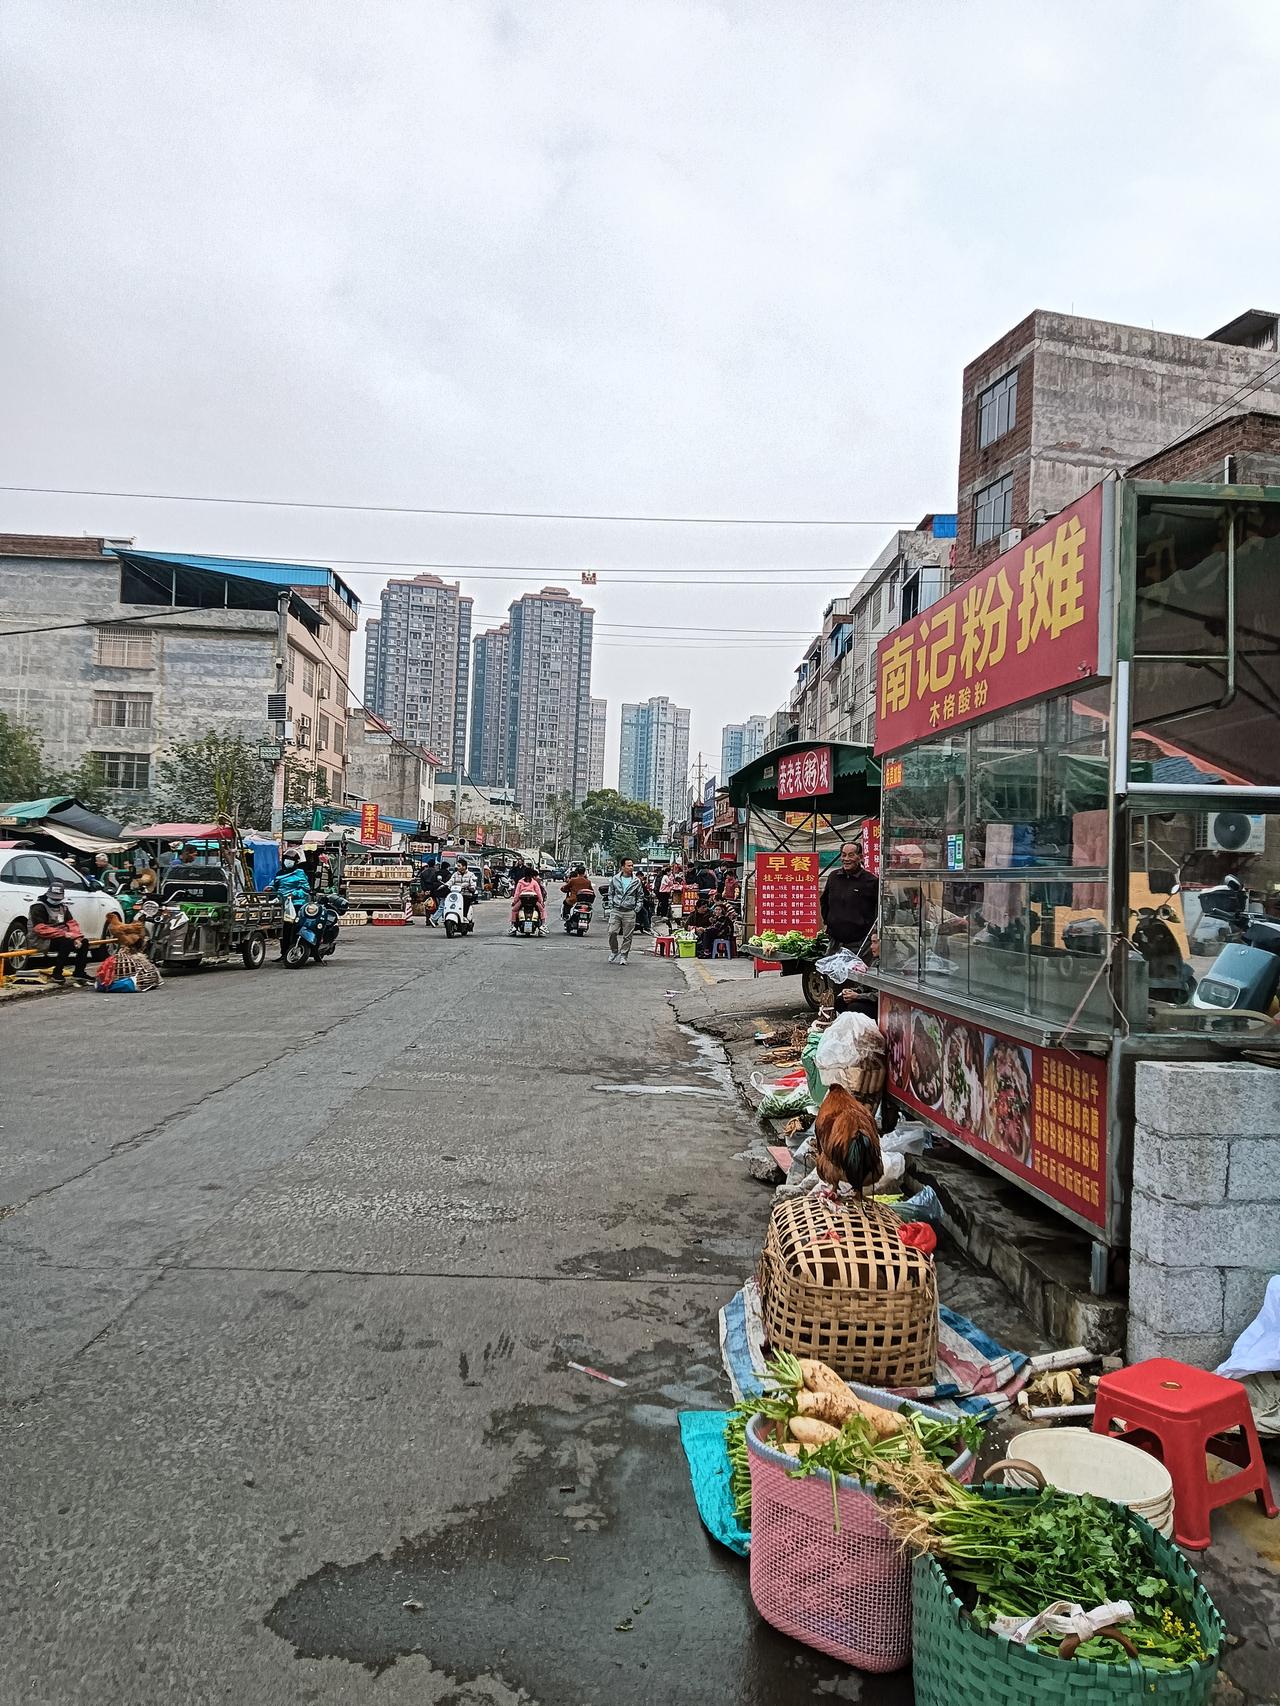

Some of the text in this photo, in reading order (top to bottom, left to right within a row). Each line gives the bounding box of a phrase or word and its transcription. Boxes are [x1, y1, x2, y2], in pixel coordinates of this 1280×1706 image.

[880, 514, 1087, 719] 南记粉摊
[929, 682, 989, 727] 木格酸粉
[766, 856, 812, 871] 早餐
